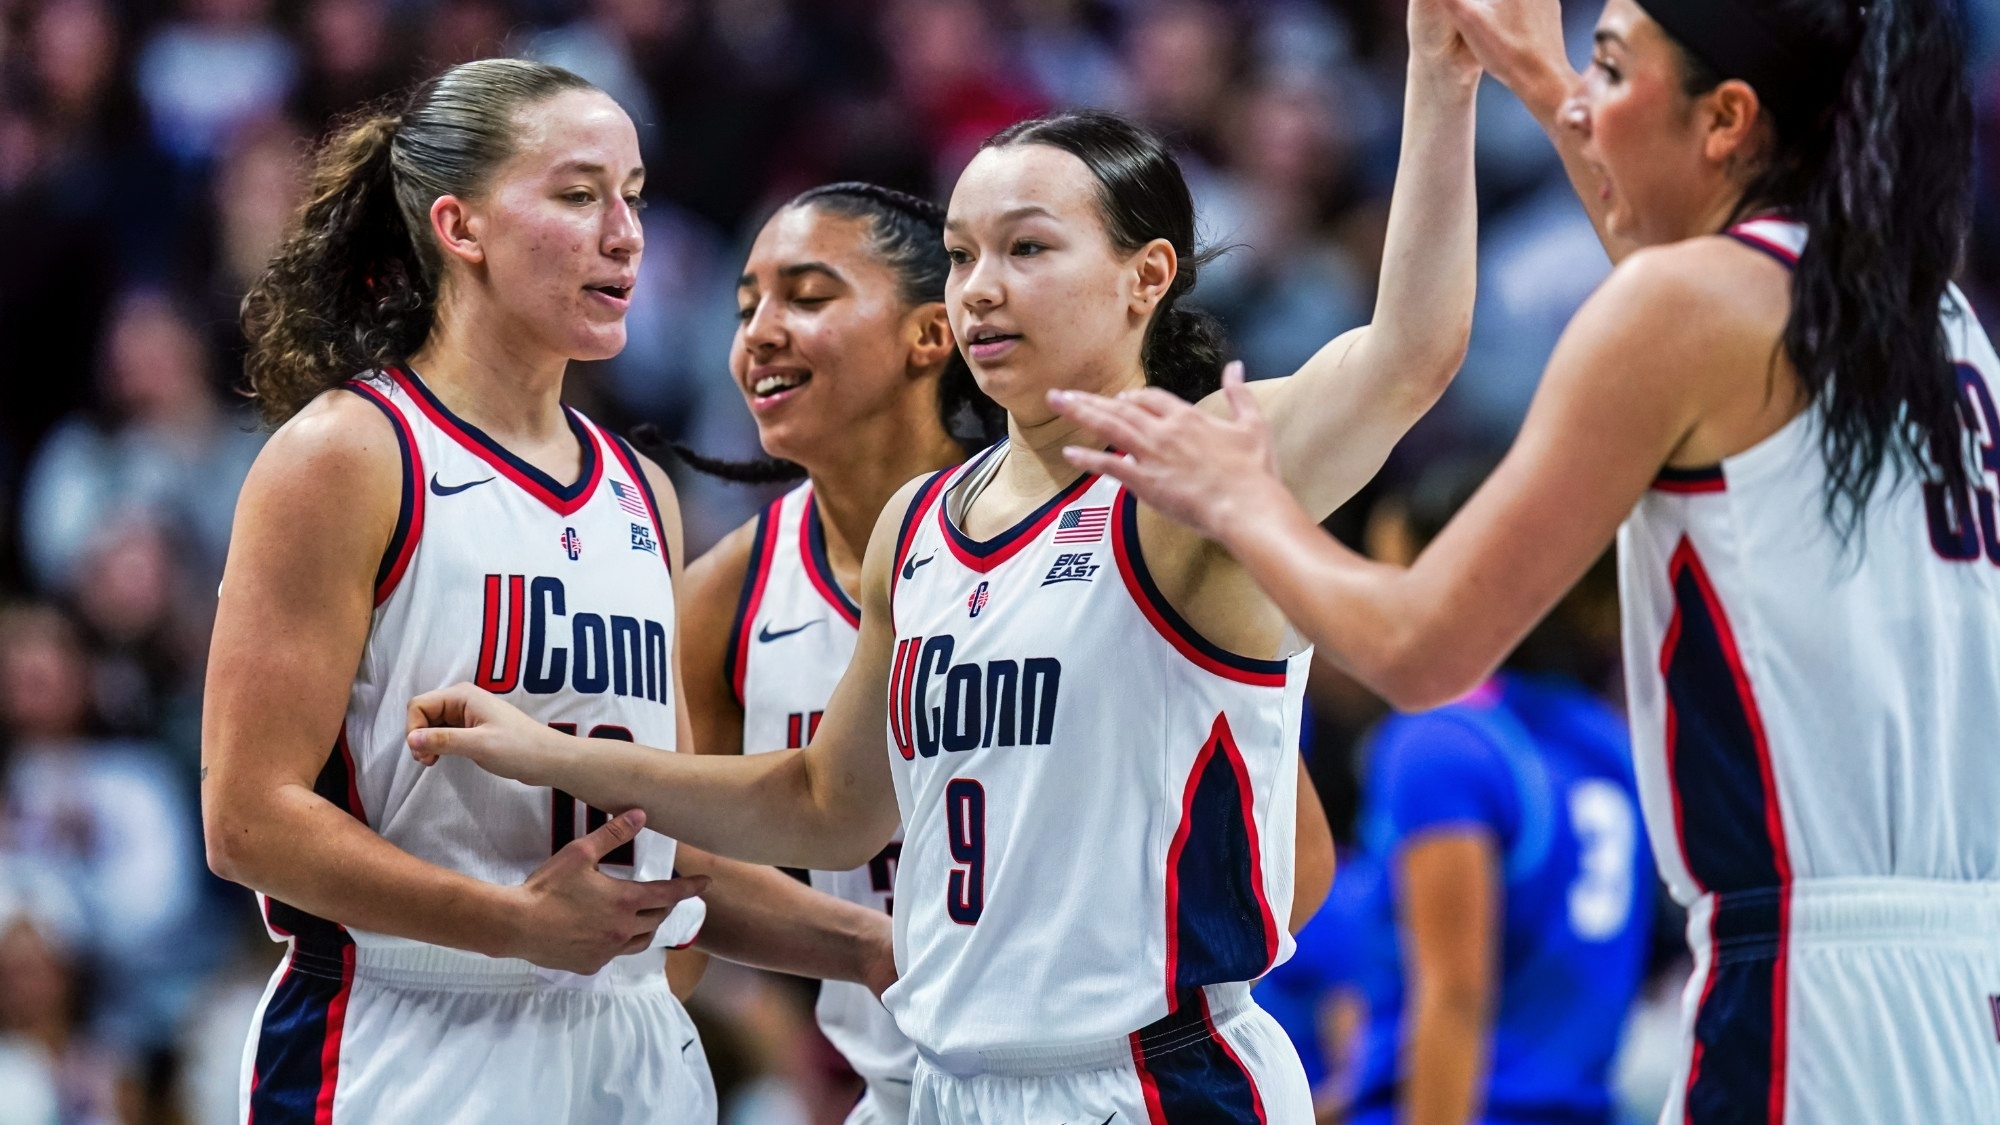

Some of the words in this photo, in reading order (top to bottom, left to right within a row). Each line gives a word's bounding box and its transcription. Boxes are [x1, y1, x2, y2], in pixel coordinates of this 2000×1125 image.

[631, 522, 649, 538] BIG
[631, 533, 657, 551] EAST
[1053, 552, 1093, 567] BIG
[1045, 565, 1101, 580] EAST
[474, 574, 667, 706] UConn
[889, 634, 1062, 761] UConn
[945, 778, 986, 926] 9
[1568, 776, 1636, 943] 3
